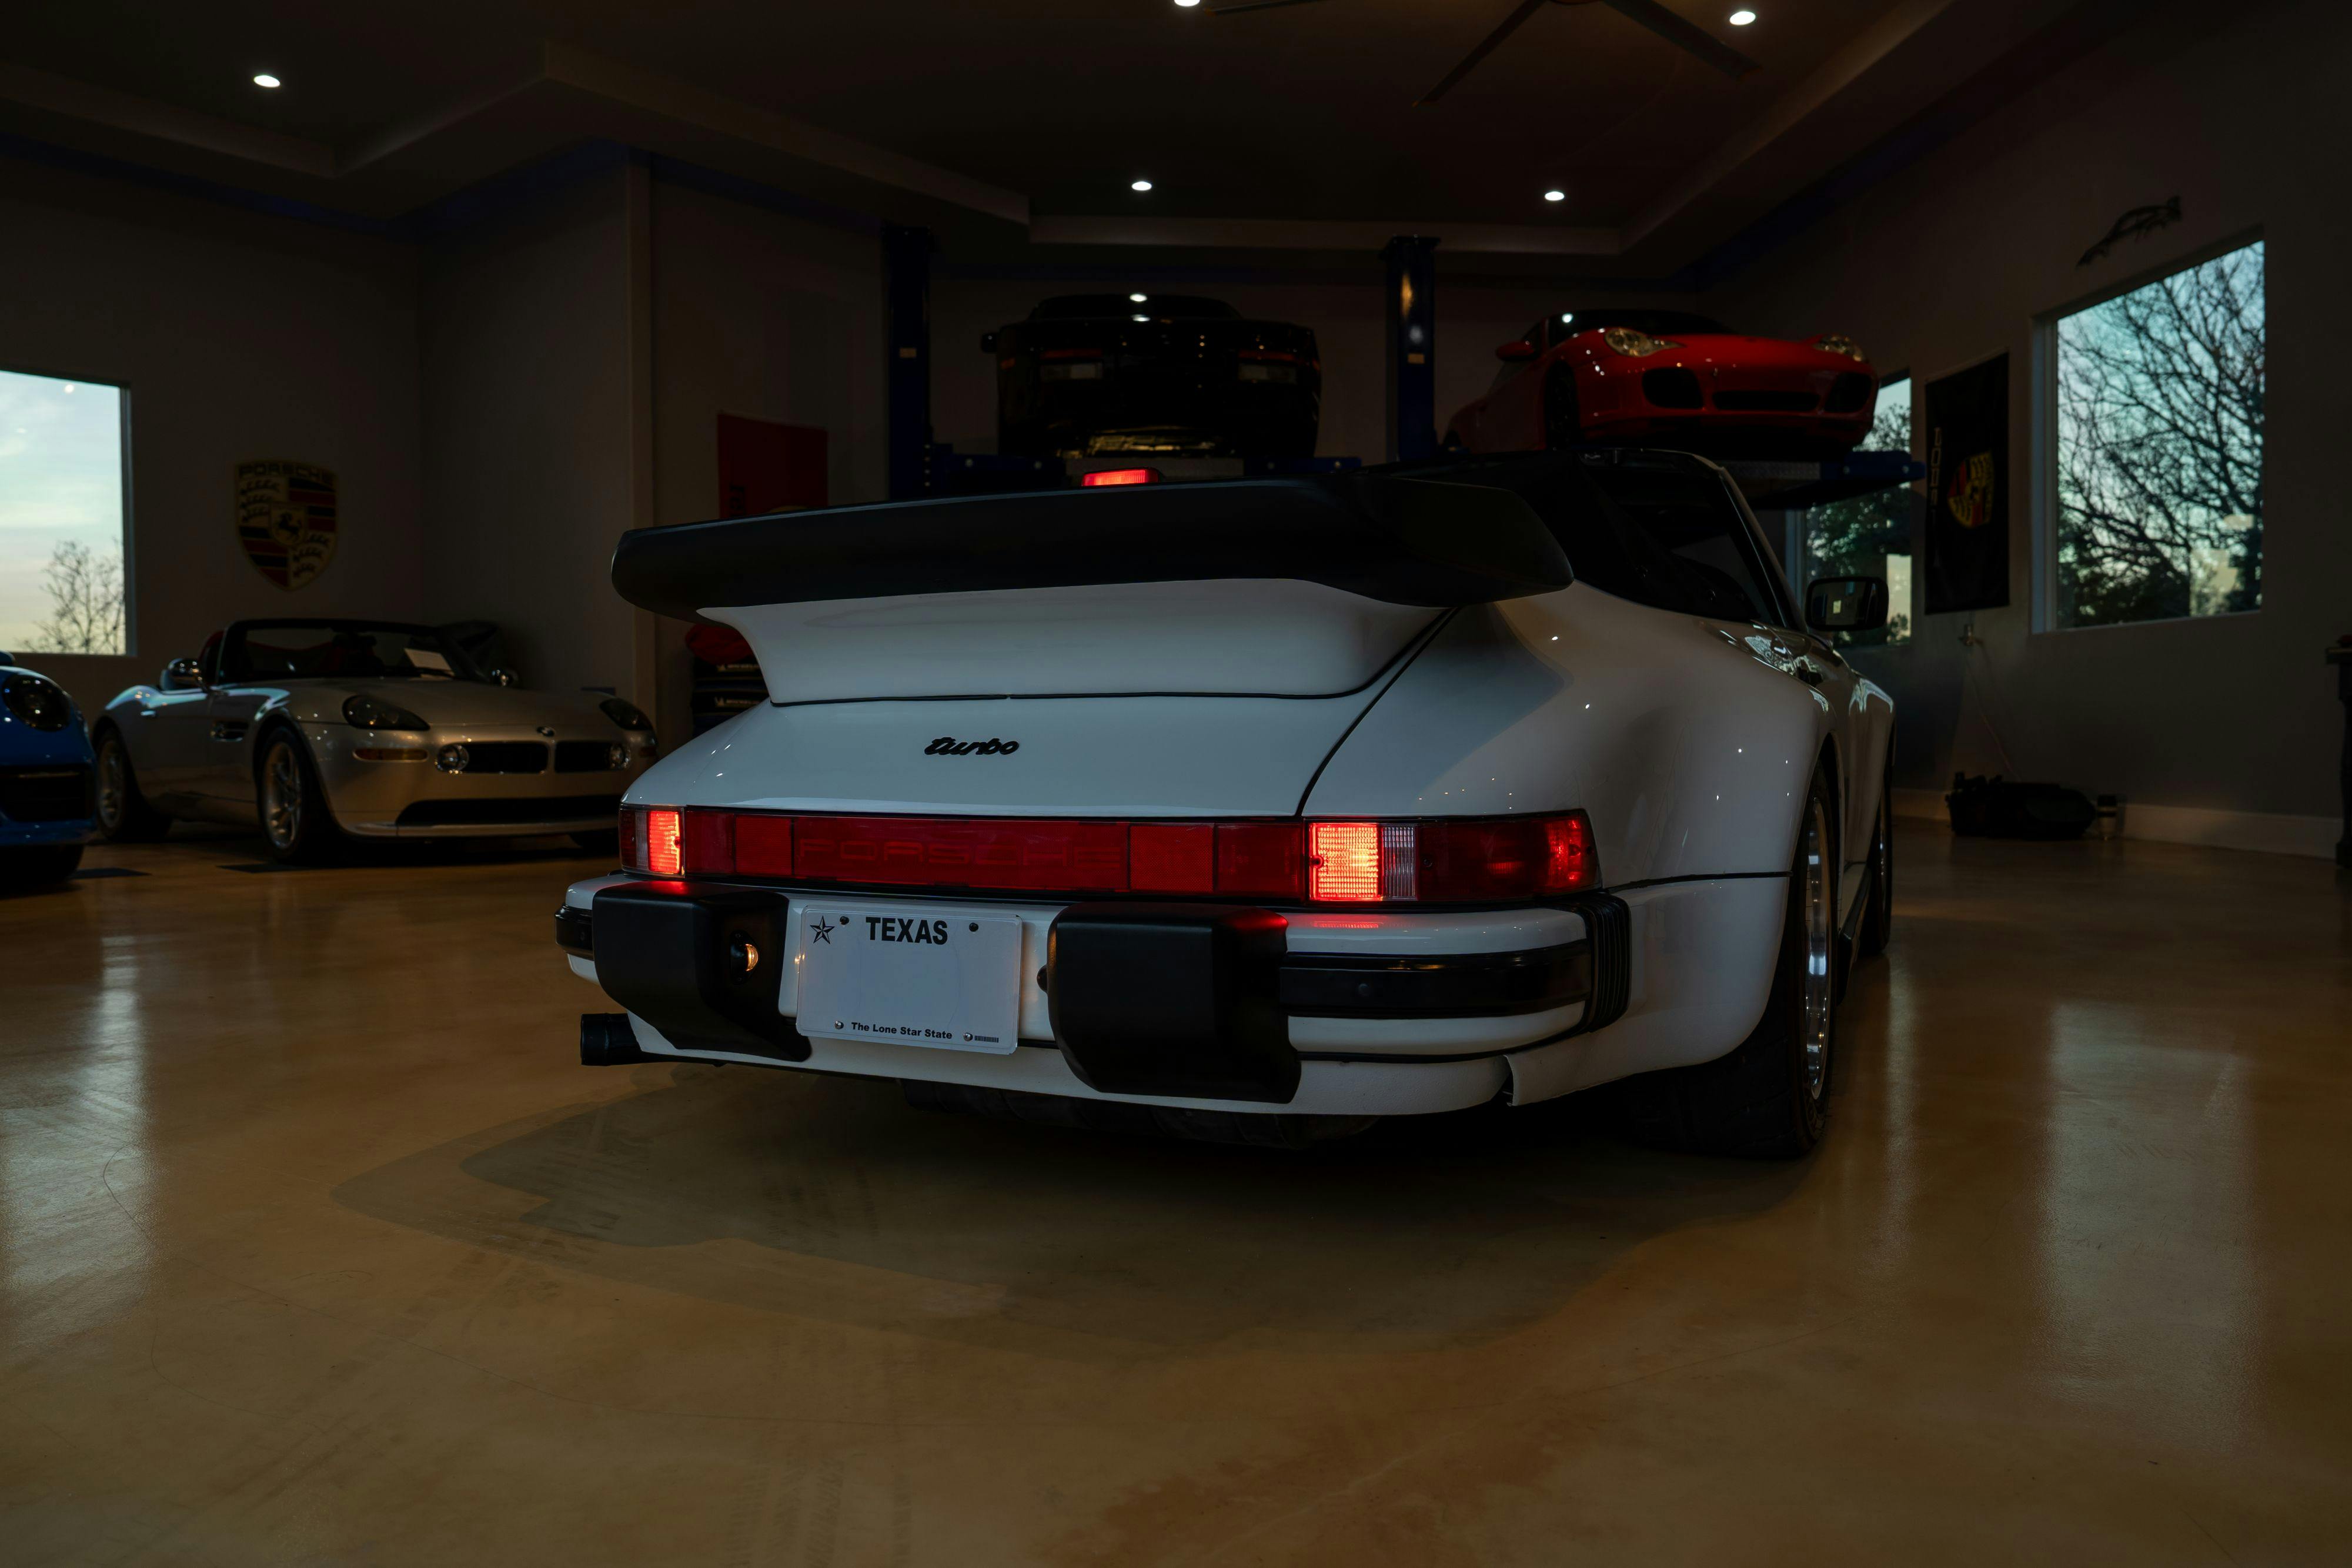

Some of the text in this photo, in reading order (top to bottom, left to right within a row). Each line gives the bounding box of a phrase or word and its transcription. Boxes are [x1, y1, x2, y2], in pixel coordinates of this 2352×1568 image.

[238, 463, 334, 487] PORSCHE
[924, 737, 1019, 755] turbo
[799, 838, 1121, 868] PORSCHE
[866, 917, 948, 945] TEXAS
[851, 1022, 952, 1039] The Lone Star State
